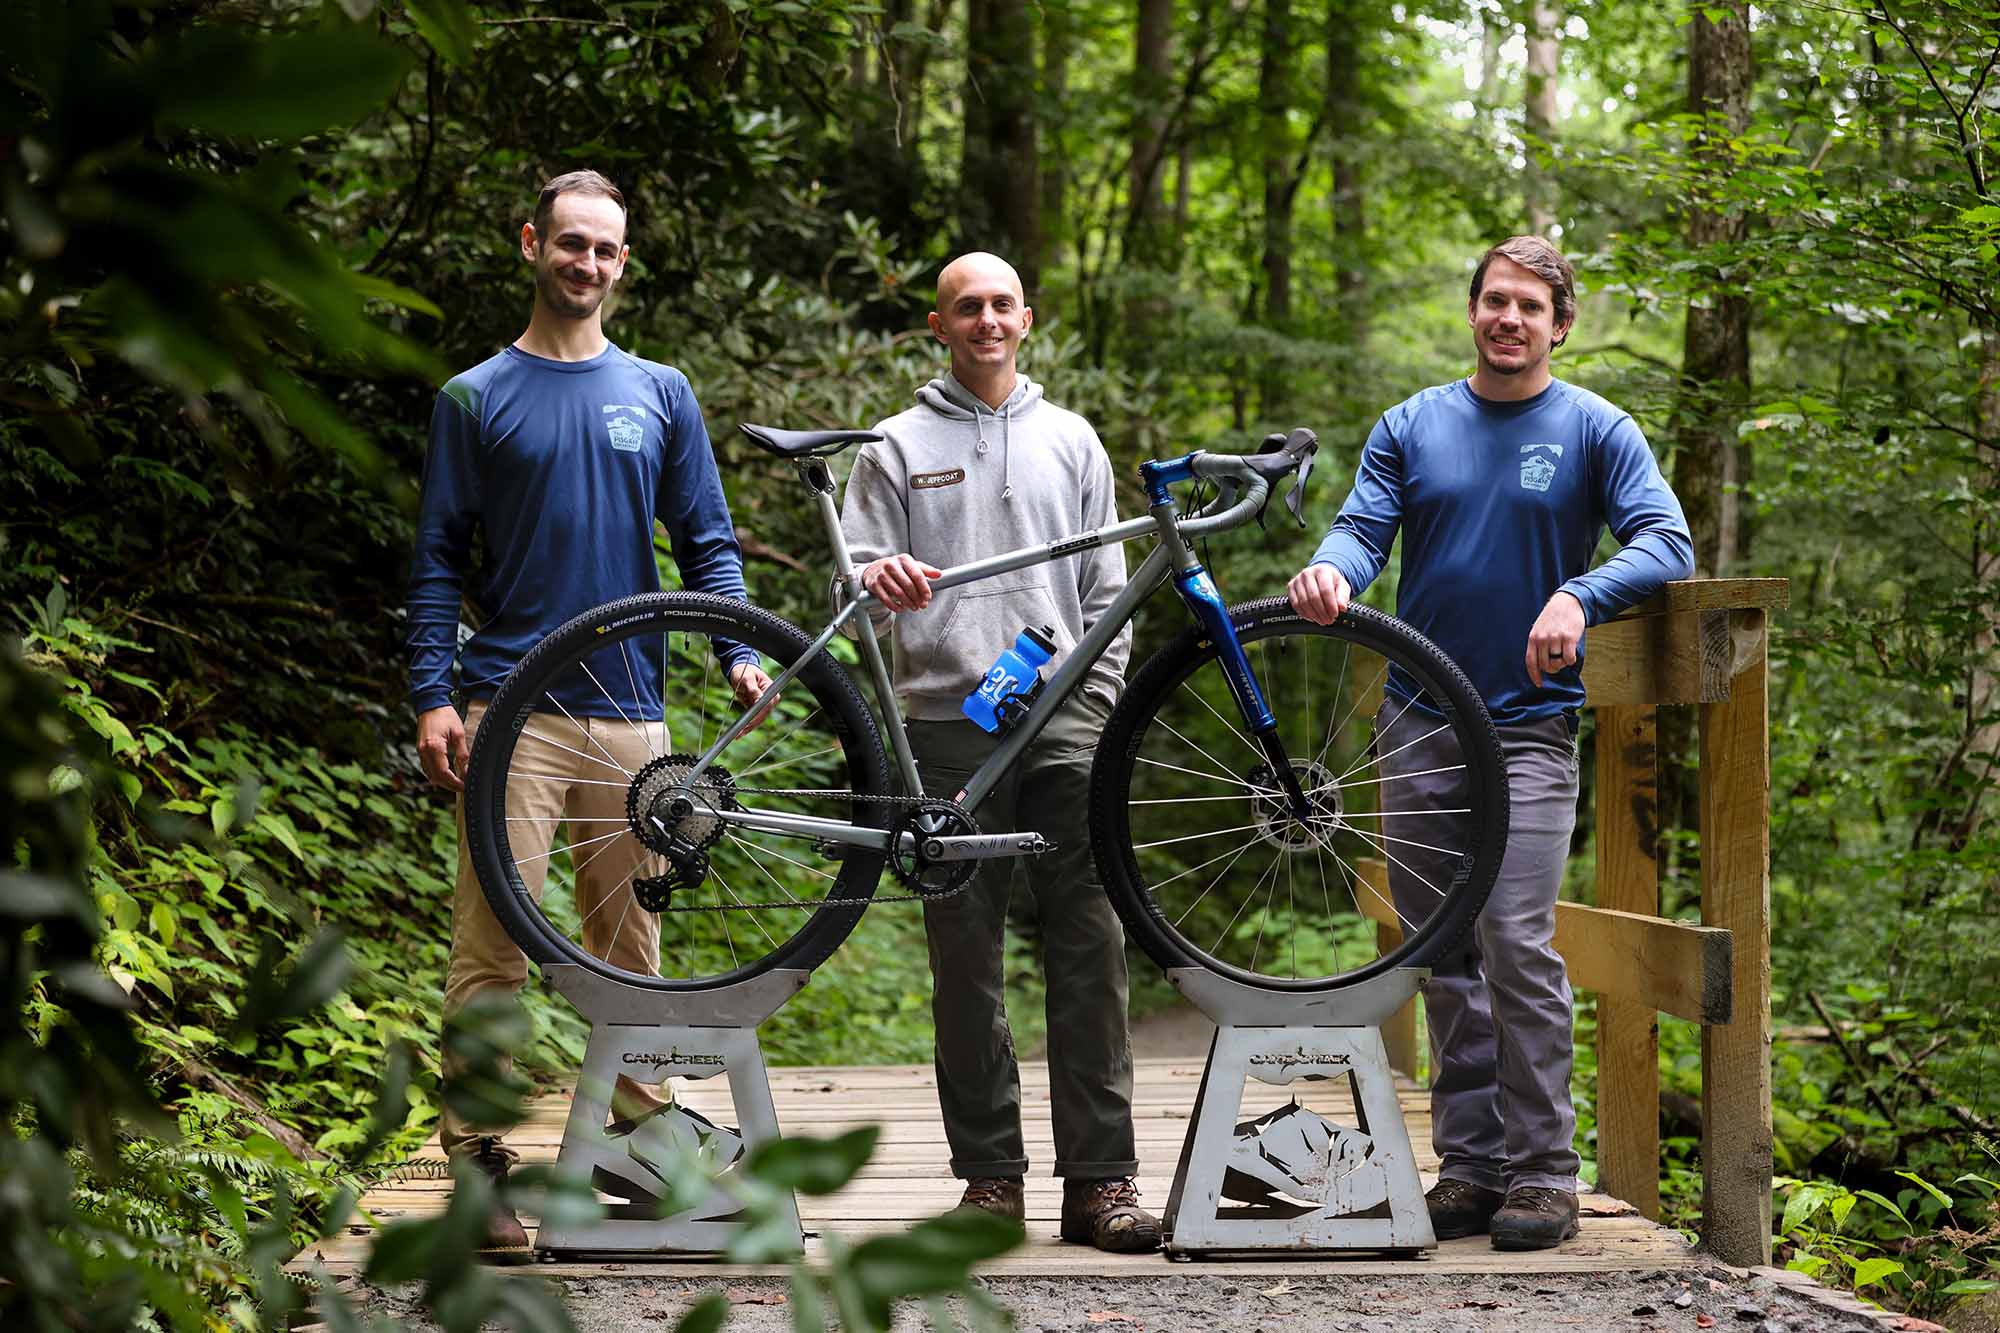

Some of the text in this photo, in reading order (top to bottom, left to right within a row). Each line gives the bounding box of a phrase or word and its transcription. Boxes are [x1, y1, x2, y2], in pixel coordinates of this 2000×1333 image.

[927, 472, 959, 484] JEFFCOAT
[612, 612, 656, 629] MICHELIN
[672, 1053, 725, 1066] CREEK
